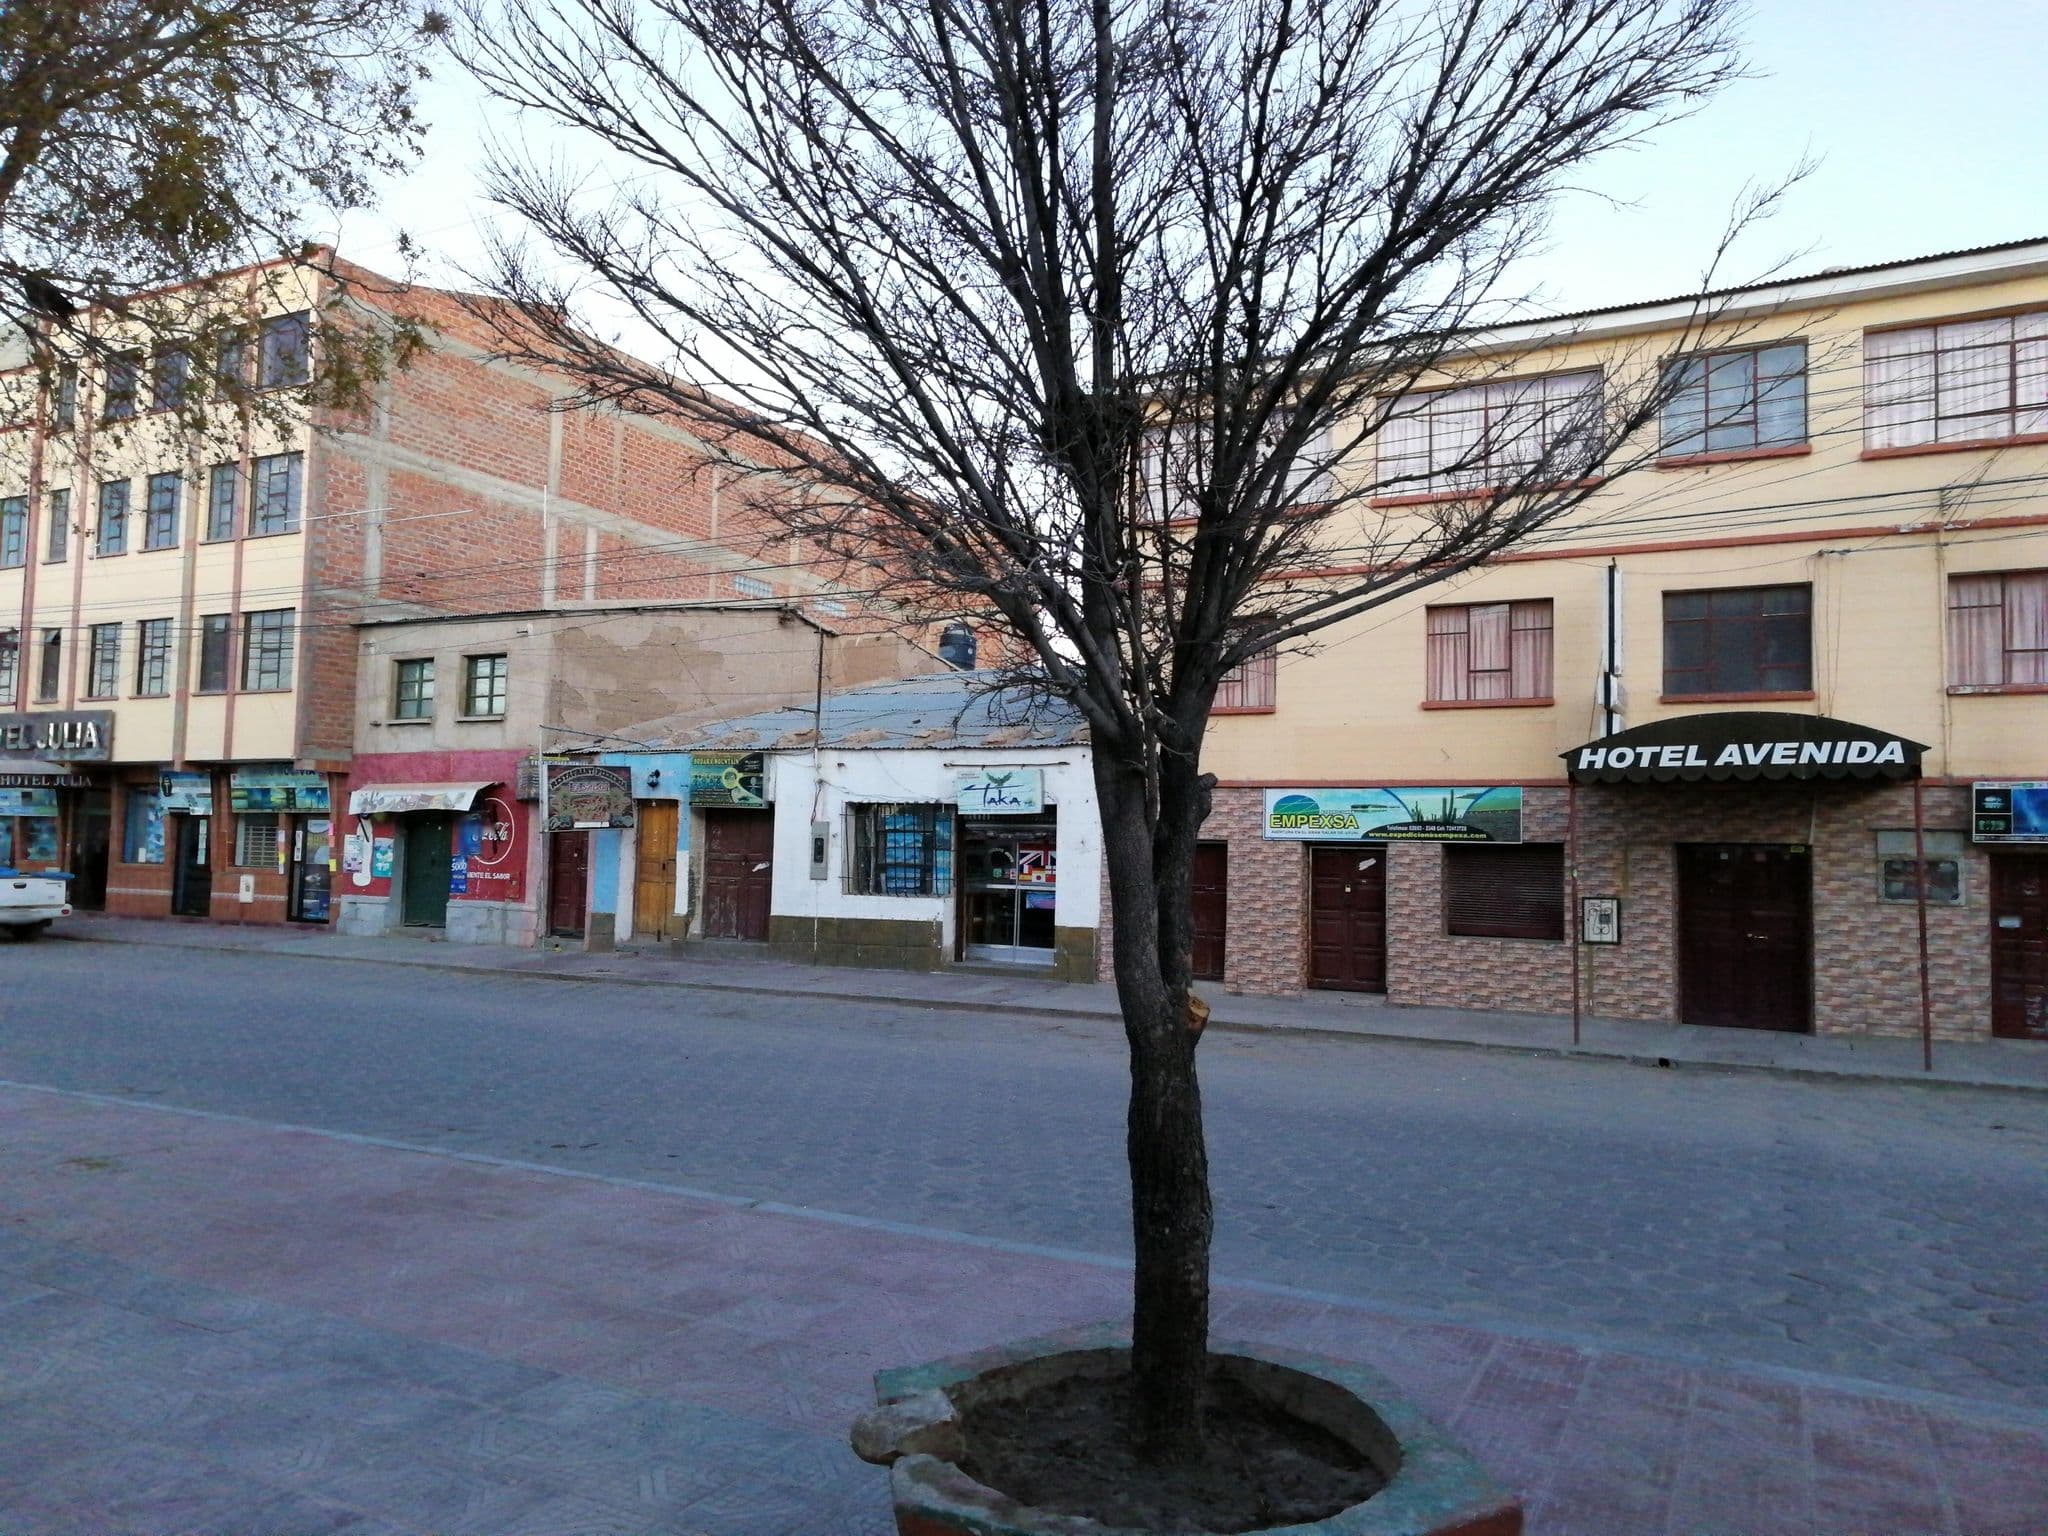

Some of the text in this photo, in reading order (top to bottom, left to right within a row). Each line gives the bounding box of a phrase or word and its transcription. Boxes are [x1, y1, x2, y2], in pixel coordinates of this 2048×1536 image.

[36, 721, 98, 750] JULIA
[1578, 741, 1905, 770] HOTEL AVENIDA
[0, 775, 92, 786] HOTEL JULIA
[551, 767, 594, 789] RESTAURANT
[1270, 814, 1360, 829] EMPEXSA
